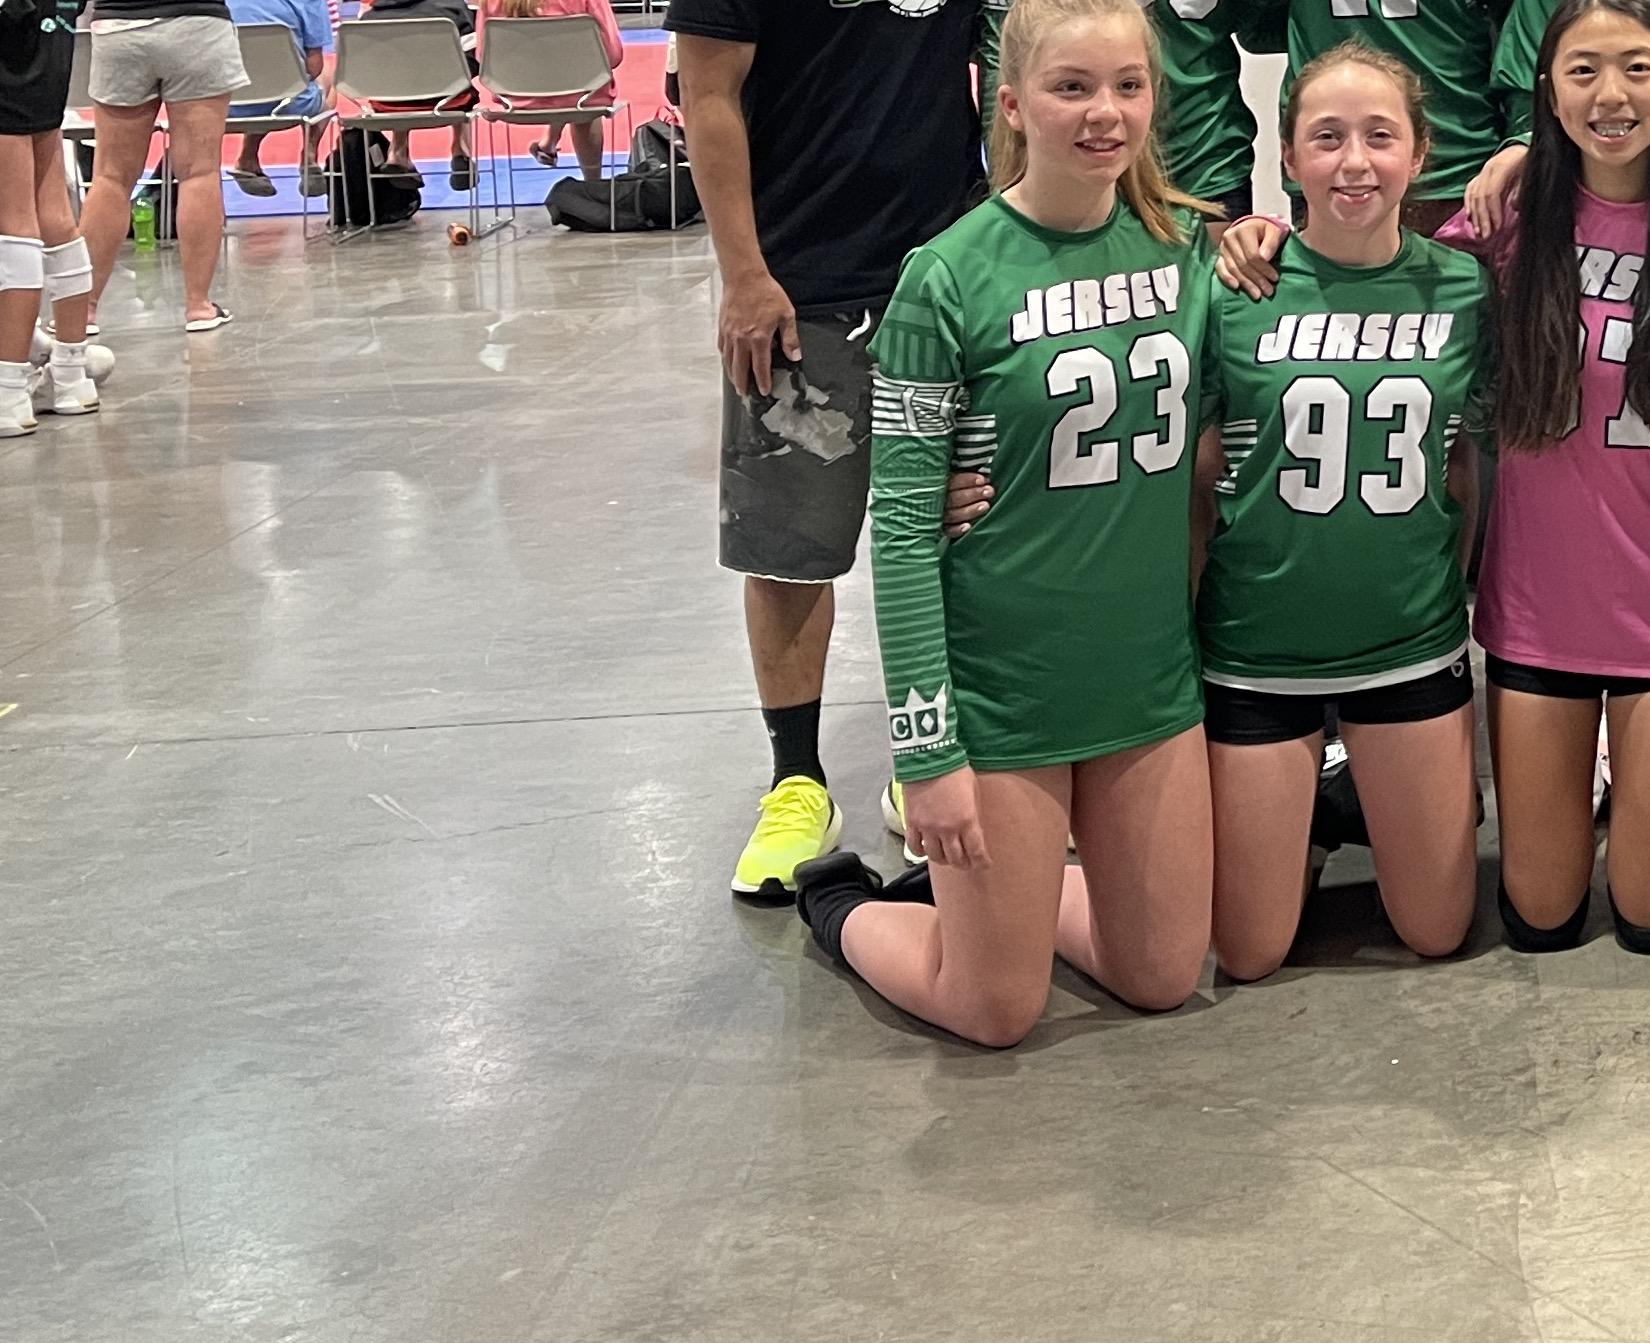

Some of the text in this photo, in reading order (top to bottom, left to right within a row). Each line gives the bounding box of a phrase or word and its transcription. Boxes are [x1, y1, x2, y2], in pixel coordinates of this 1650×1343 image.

[1011, 264, 1180, 344] JERSEY
[1256, 313, 1454, 364] JERSEY
[1046, 331, 1191, 490] 23
[1278, 375, 1433, 516] 93
